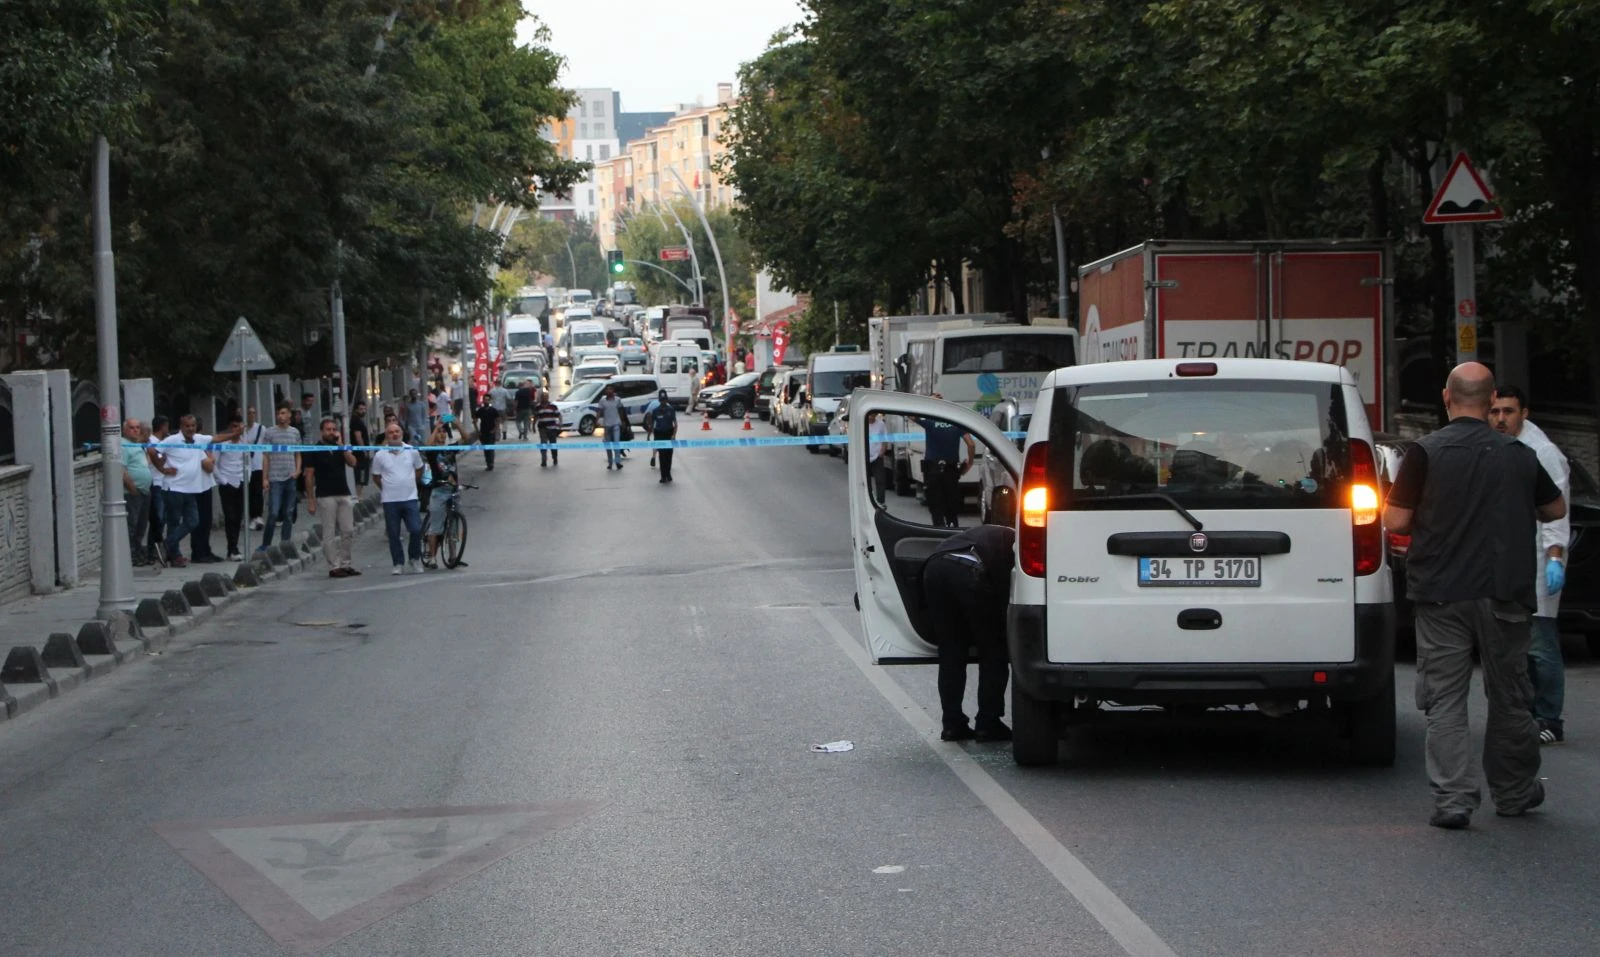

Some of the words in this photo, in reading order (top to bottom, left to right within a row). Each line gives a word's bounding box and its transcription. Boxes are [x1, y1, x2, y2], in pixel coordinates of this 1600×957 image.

[1150, 560, 1171, 578] 34
[1184, 560, 1205, 578] TP
[1214, 560, 1255, 578] 5170
